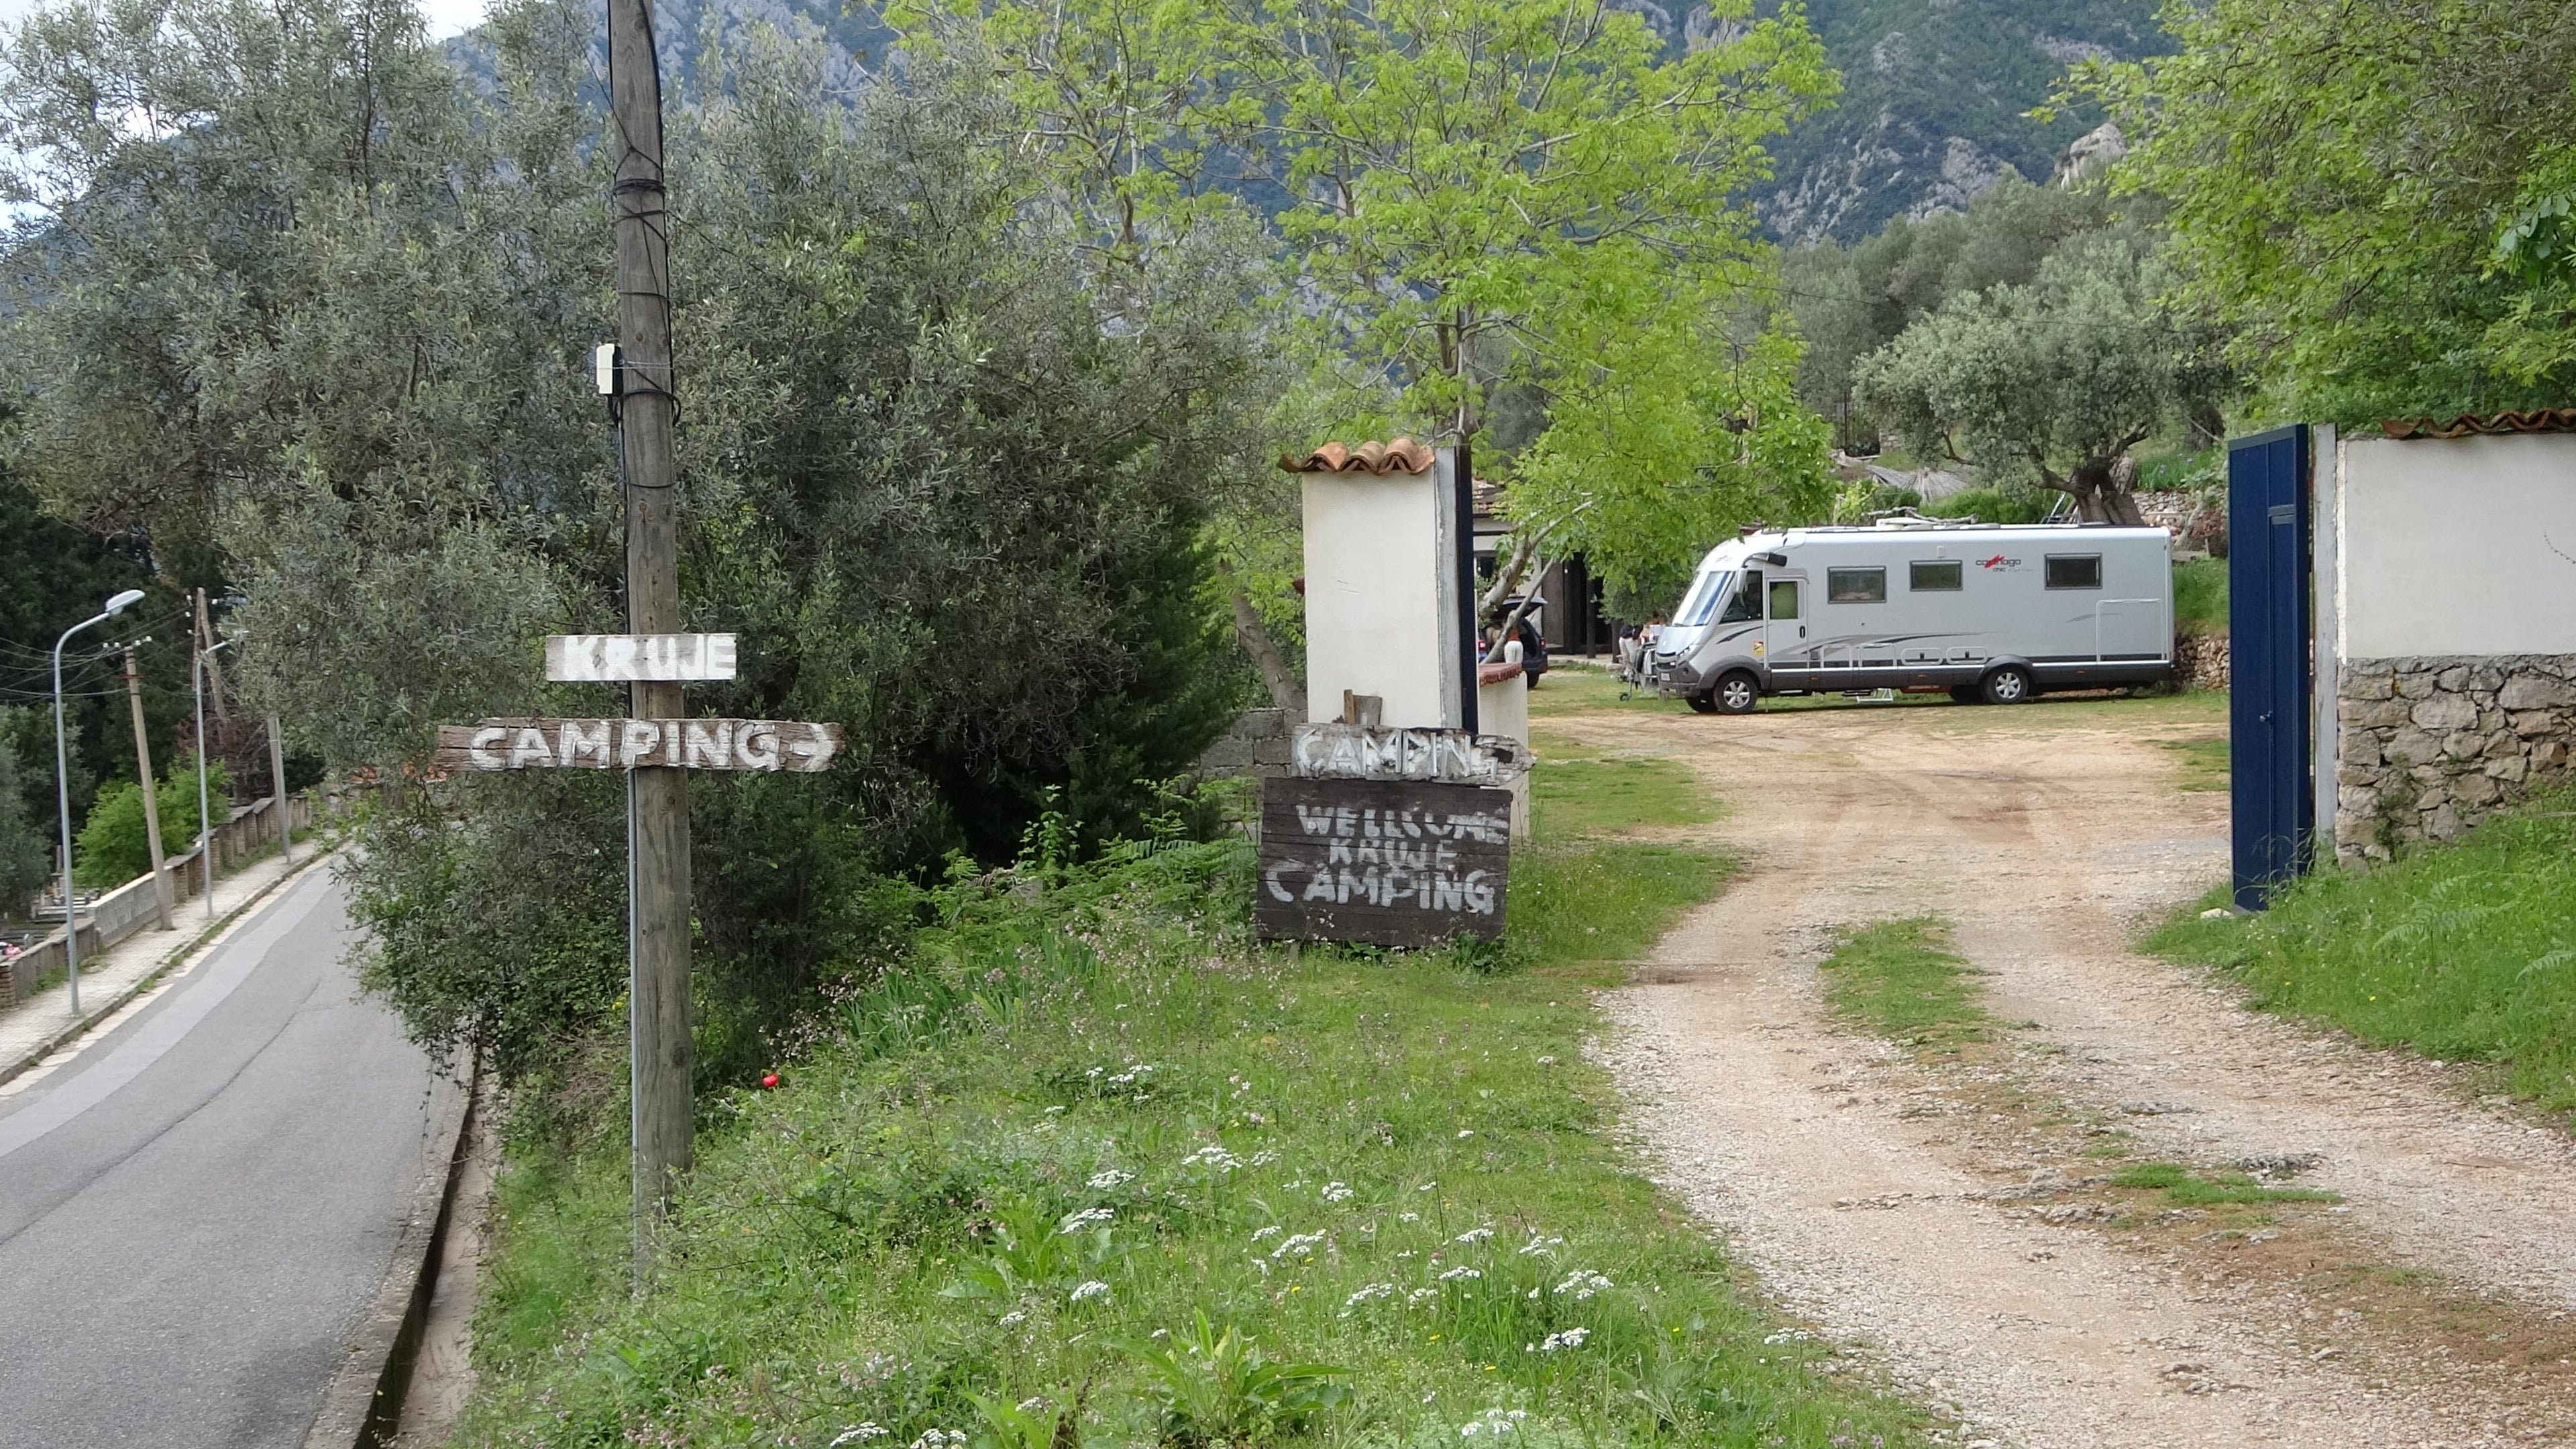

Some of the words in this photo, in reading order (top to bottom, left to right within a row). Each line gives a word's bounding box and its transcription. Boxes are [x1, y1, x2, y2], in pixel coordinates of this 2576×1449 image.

[1975, 555, 2021, 568] cahago
[470, 720, 781, 772] CAMPING
[1265, 861, 1496, 916] CAMPING
